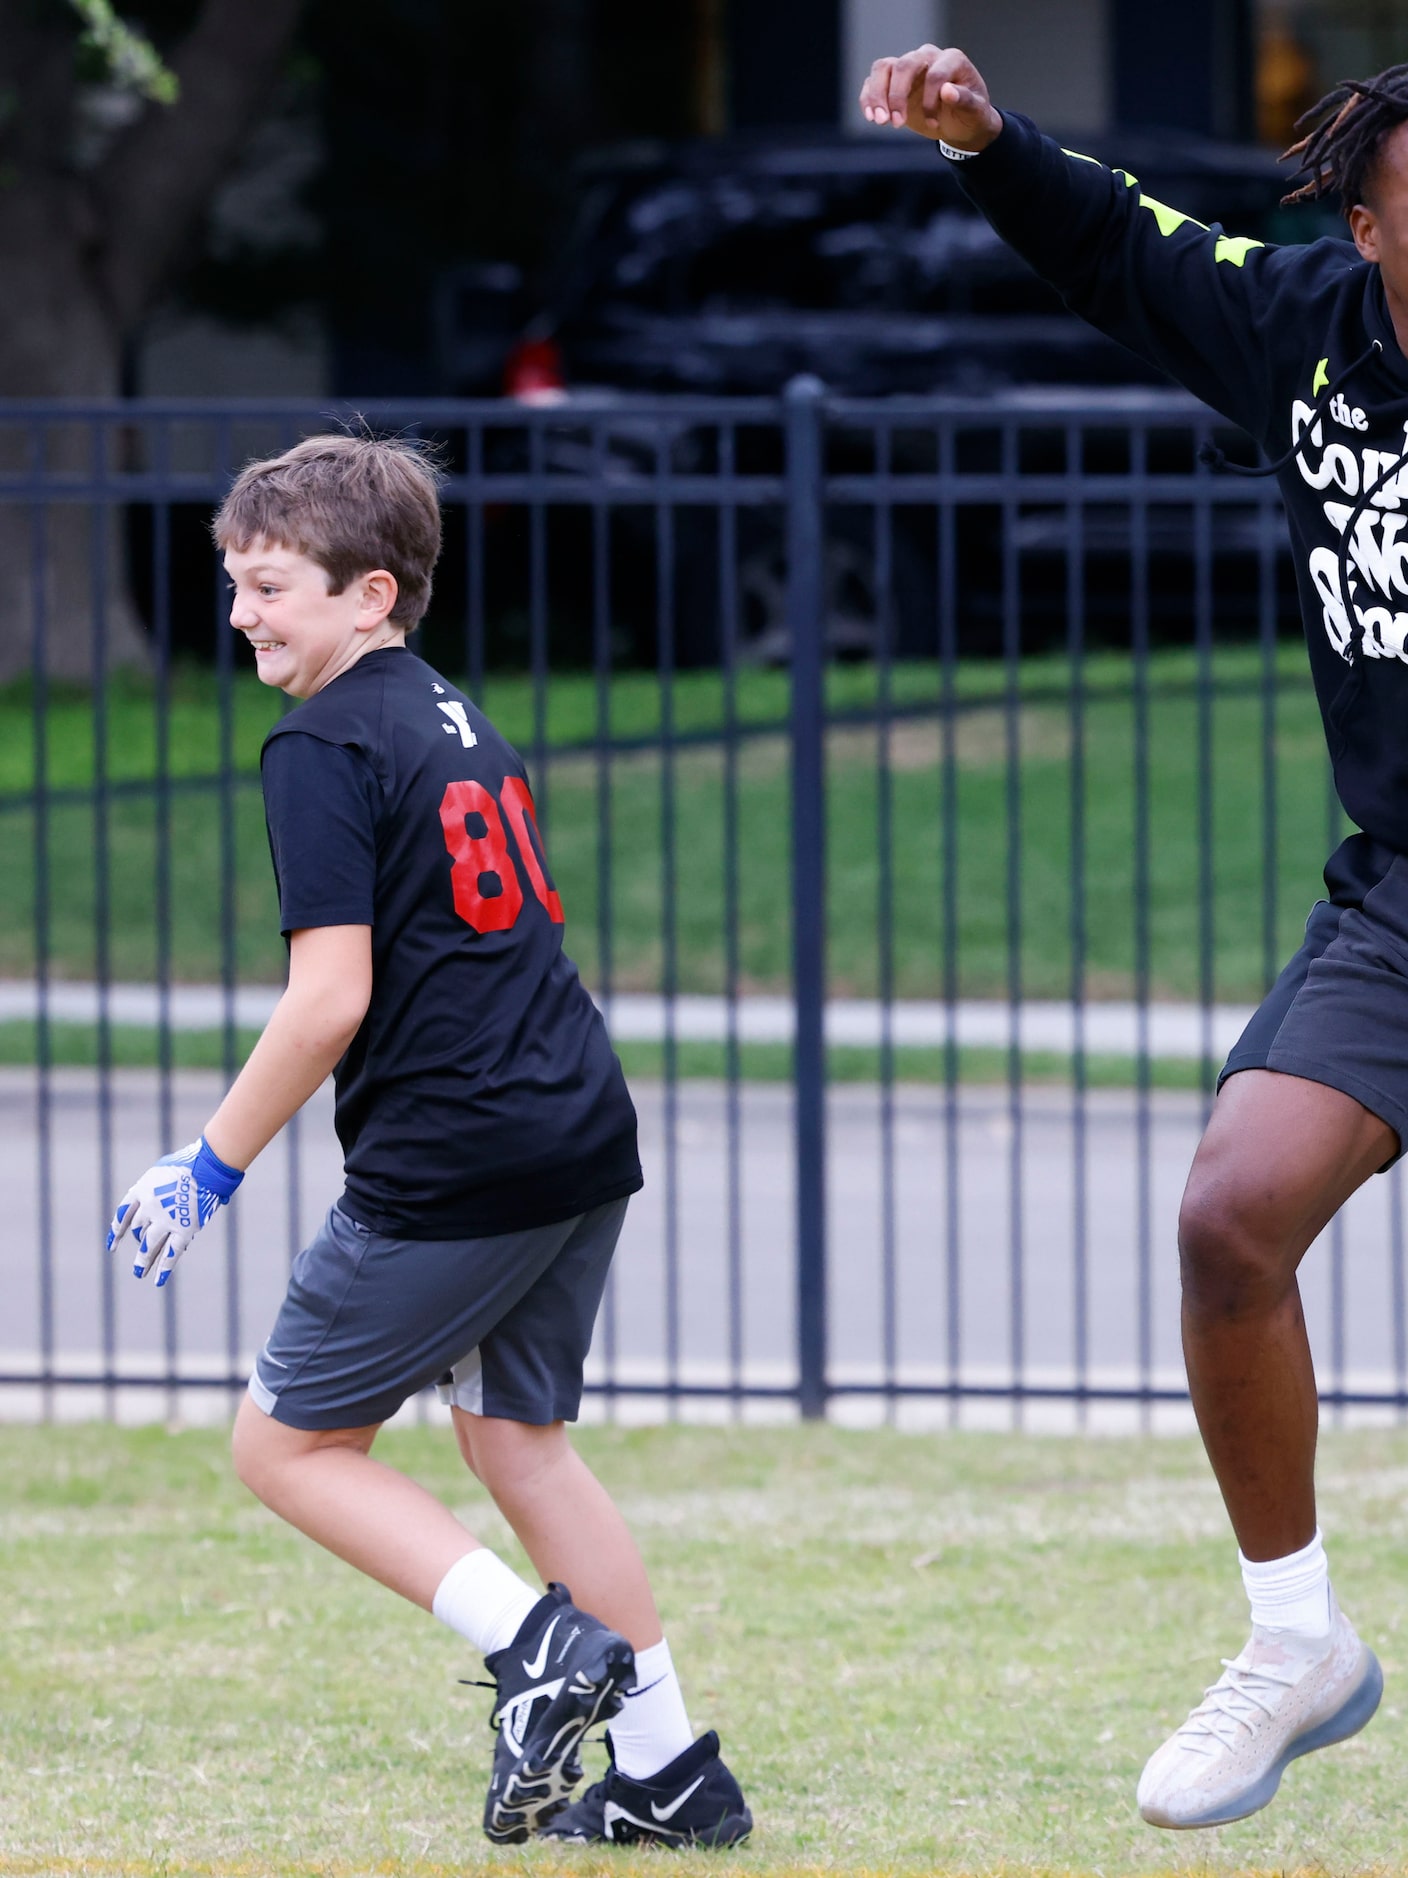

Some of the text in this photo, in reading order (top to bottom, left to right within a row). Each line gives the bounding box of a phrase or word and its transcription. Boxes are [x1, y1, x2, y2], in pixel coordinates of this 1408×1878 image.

[1329, 393, 1369, 432] the
[438, 775, 566, 935] 80
[174, 1174, 191, 1228] adidas
